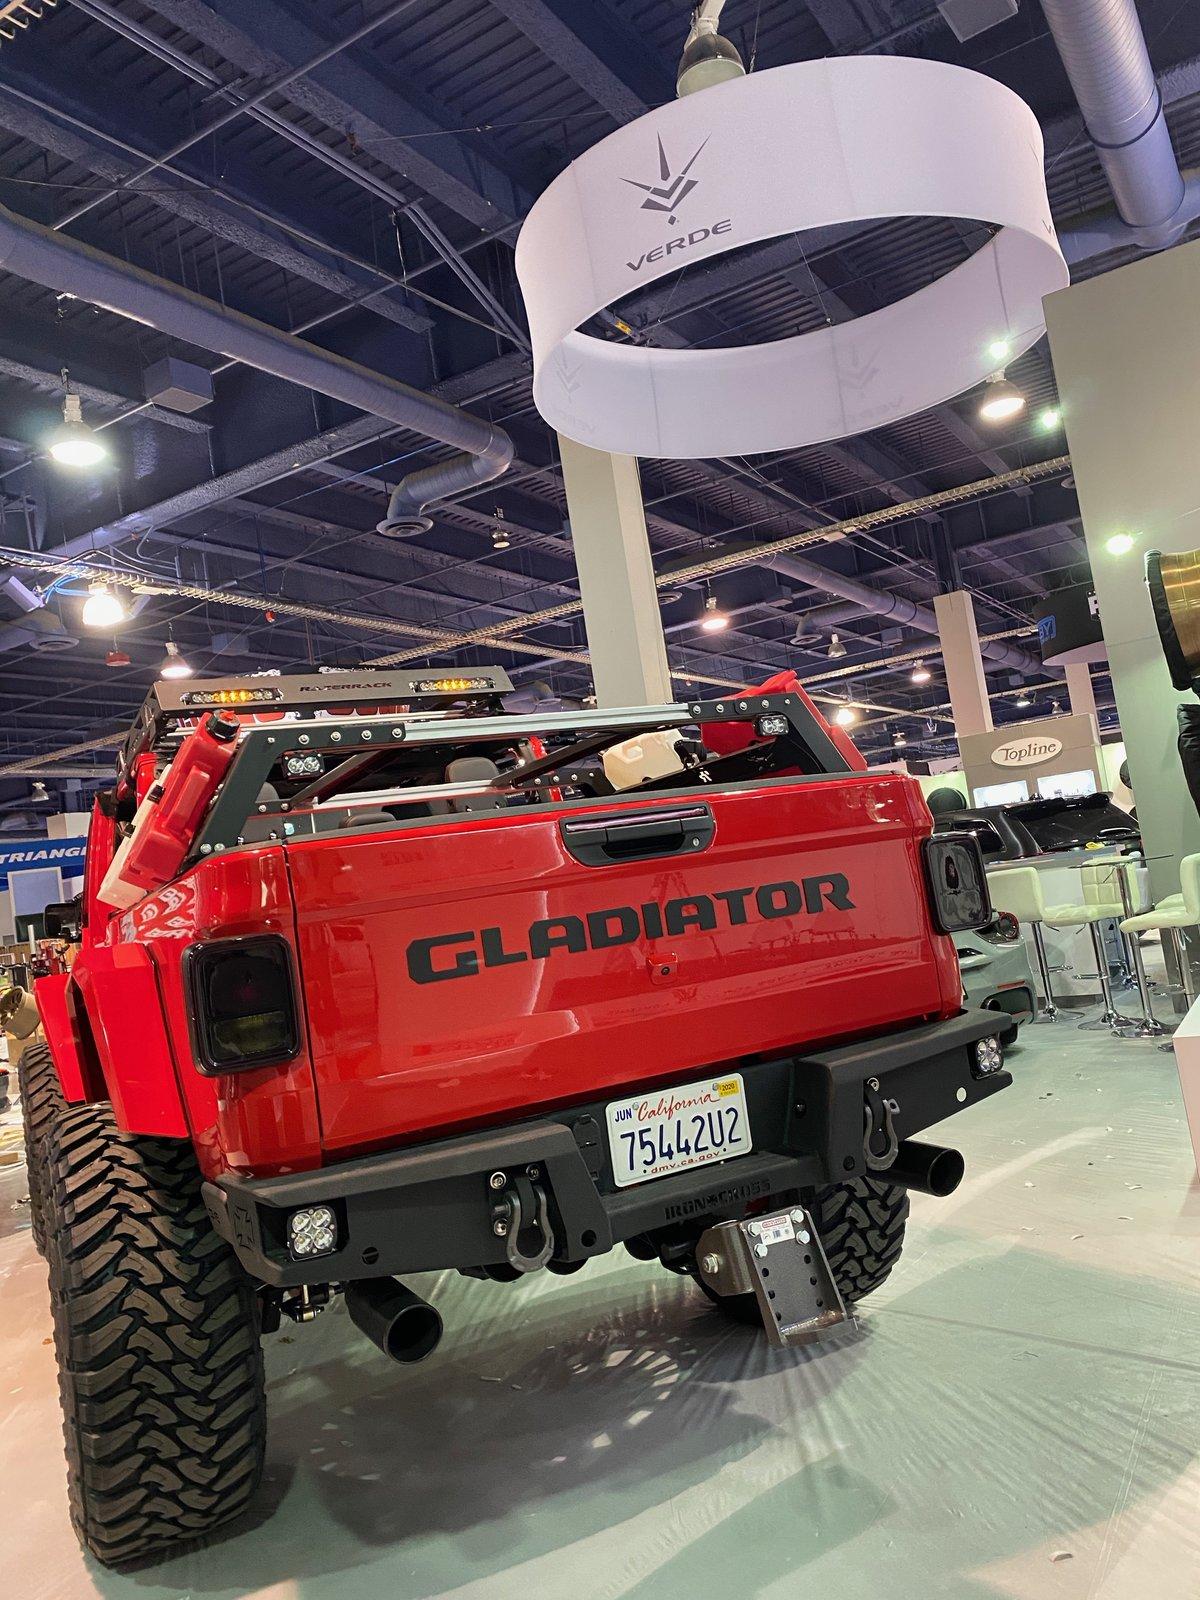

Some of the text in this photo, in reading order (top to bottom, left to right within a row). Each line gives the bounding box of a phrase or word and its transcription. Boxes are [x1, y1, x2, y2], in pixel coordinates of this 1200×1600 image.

[626, 218, 732, 272] VERDE
[998, 743, 1056, 762] Topline
[405, 872, 856, 985] GLADIATOR
[614, 1091, 721, 1123] JUN California
[620, 1107, 742, 1171] 75442U2
[651, 1151, 721, 1174] dmv.ca.gov
[664, 1197, 706, 1220] IRON
